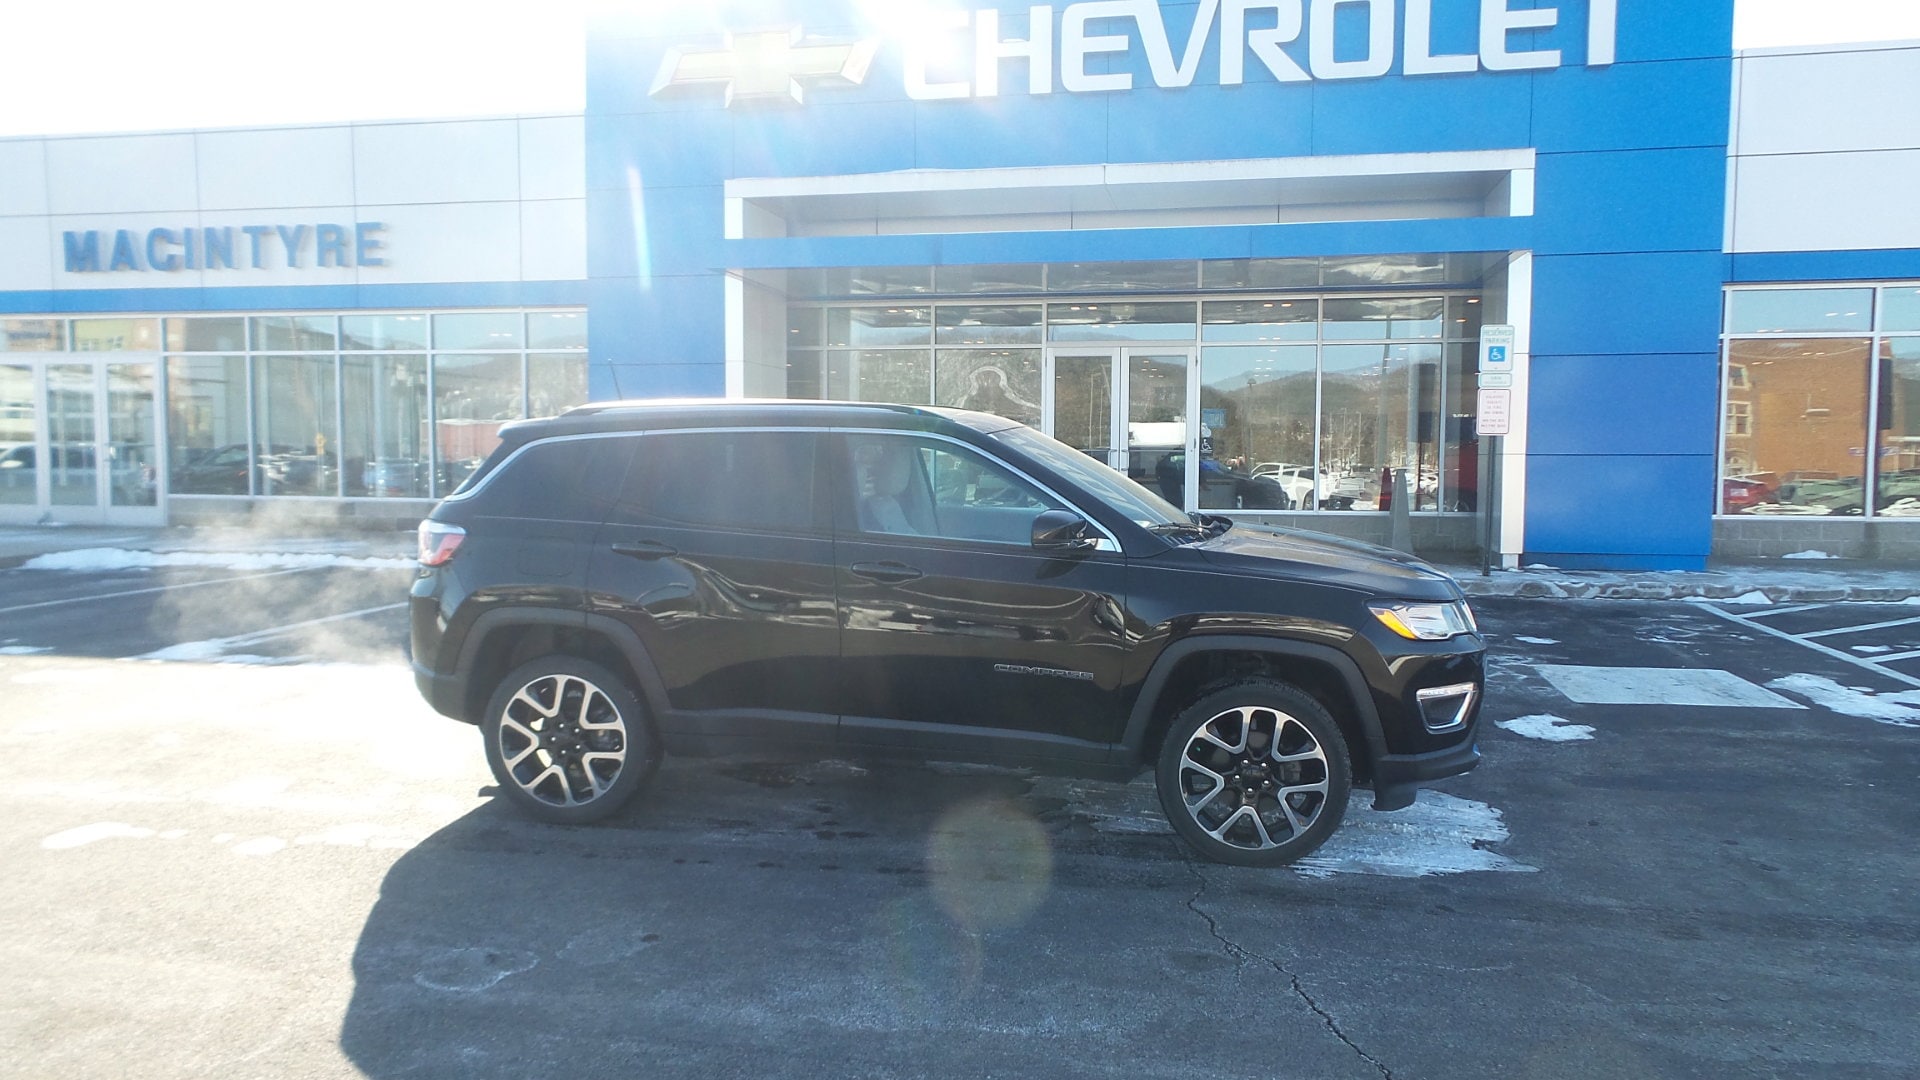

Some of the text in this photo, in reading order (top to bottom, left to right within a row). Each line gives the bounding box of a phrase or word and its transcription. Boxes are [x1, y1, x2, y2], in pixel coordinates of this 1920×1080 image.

[903, 0, 1617, 100] CHEVROLET
[63, 222, 388, 273] MACINTYRE
[993, 663, 1094, 681] COMPASS
